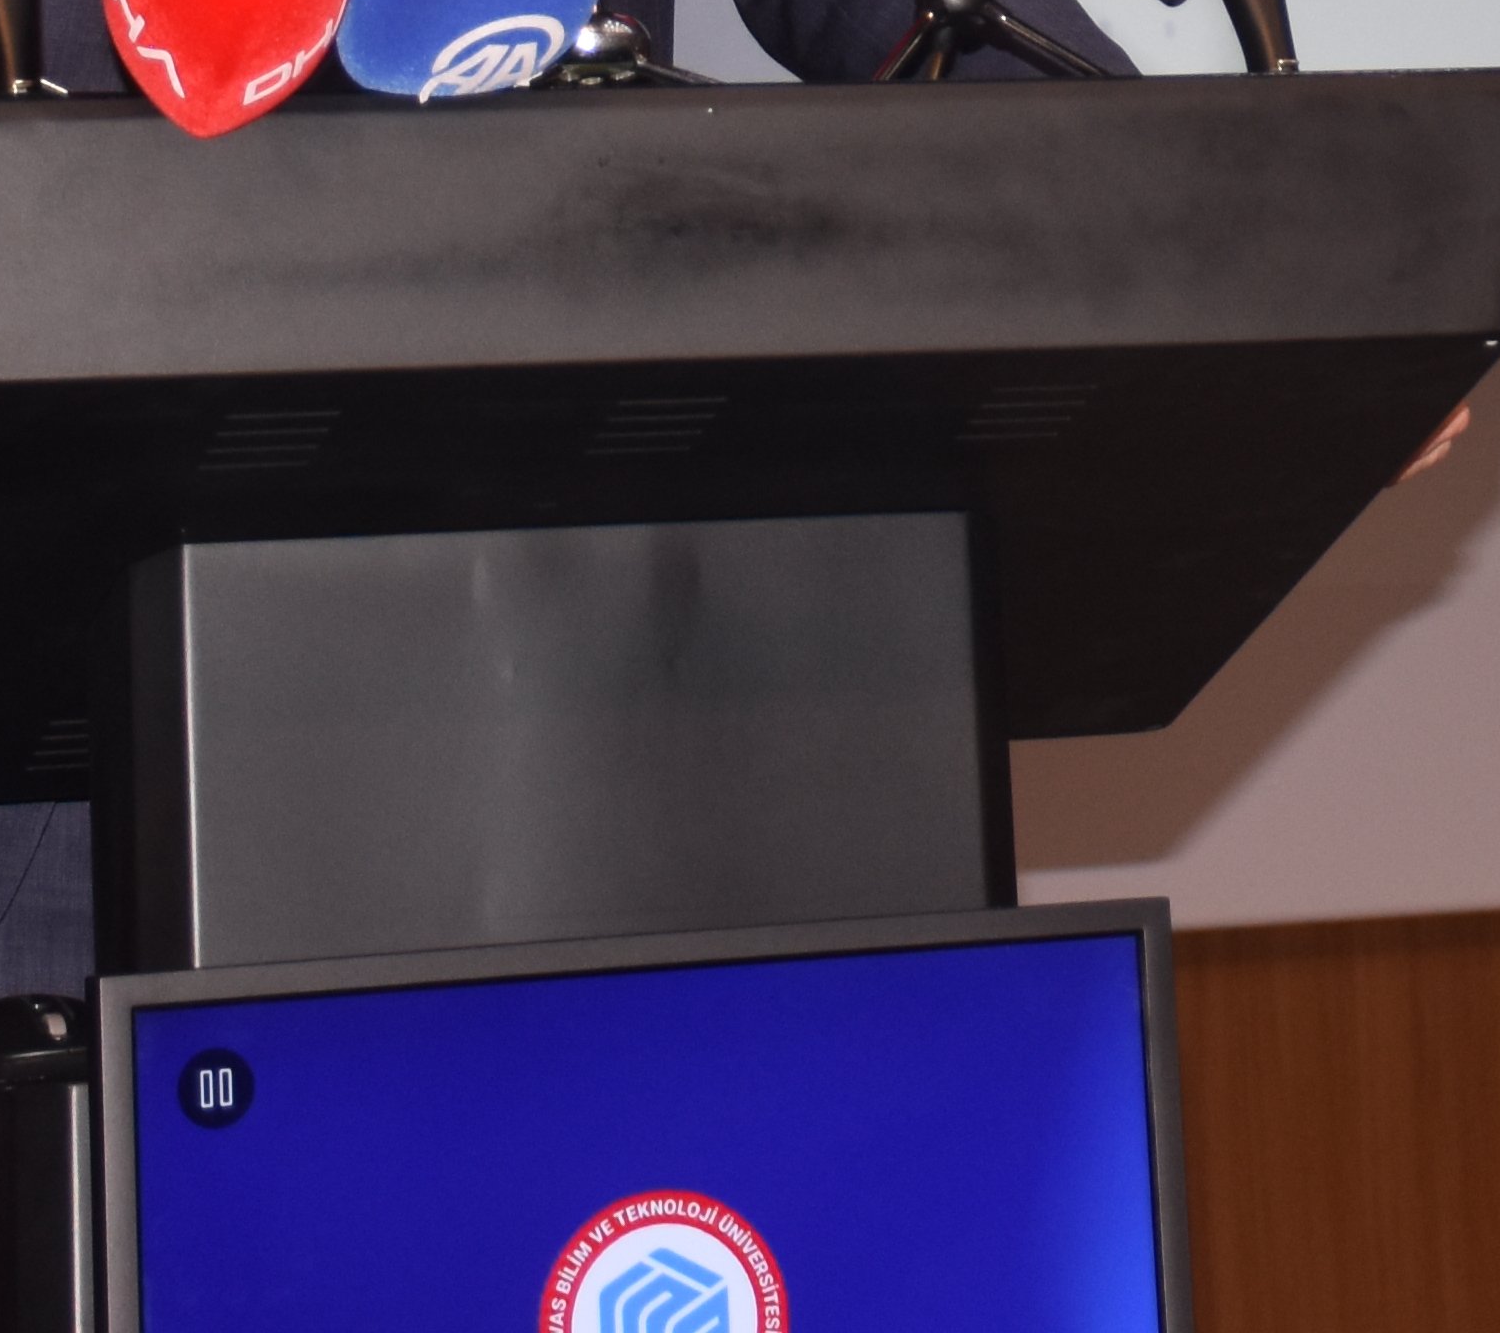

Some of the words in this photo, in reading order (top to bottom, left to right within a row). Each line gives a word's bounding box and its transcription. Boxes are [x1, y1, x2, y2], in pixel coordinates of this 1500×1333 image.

[556, 1239, 593, 1296] BİLİM
[588, 1218, 615, 1245] VE
[612, 1198, 719, 1228] TEKNOLOJİ
